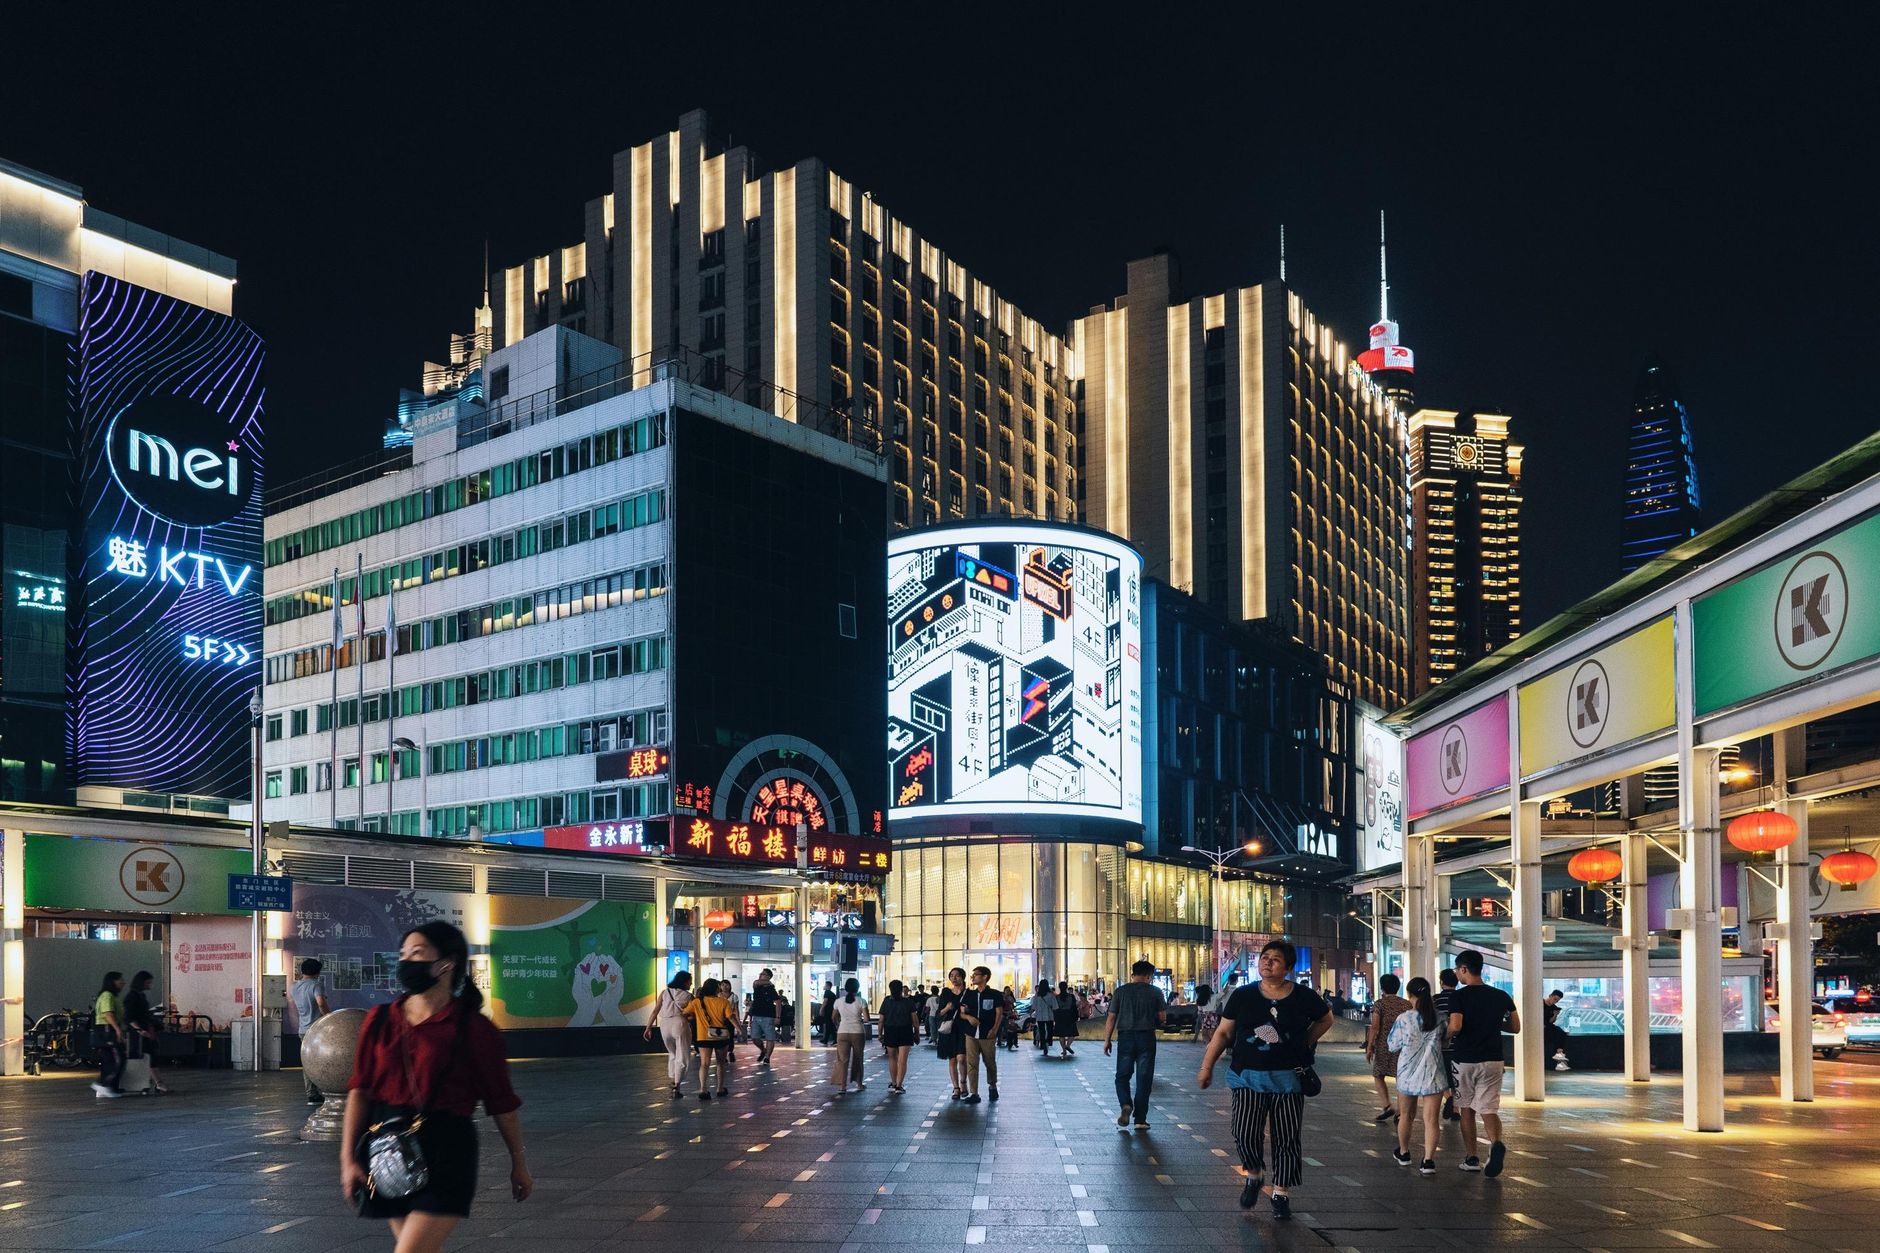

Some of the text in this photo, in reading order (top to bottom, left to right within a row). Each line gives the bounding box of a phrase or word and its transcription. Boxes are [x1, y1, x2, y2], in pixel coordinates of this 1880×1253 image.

[130, 429, 239, 496] mei
[107, 536, 251, 596] 魅 KTV
[184, 635, 218, 661] 5F
[1083, 626, 1102, 648] 4F
[958, 755, 982, 776] 4F
[688, 818, 788, 860] 新福楼
[859, 852, 888, 868] 二楼
[296, 910, 330, 920] 社会主义
[503, 955, 558, 964] 关爱下一代成长
[503, 969, 558, 978] 保护青少年权益
